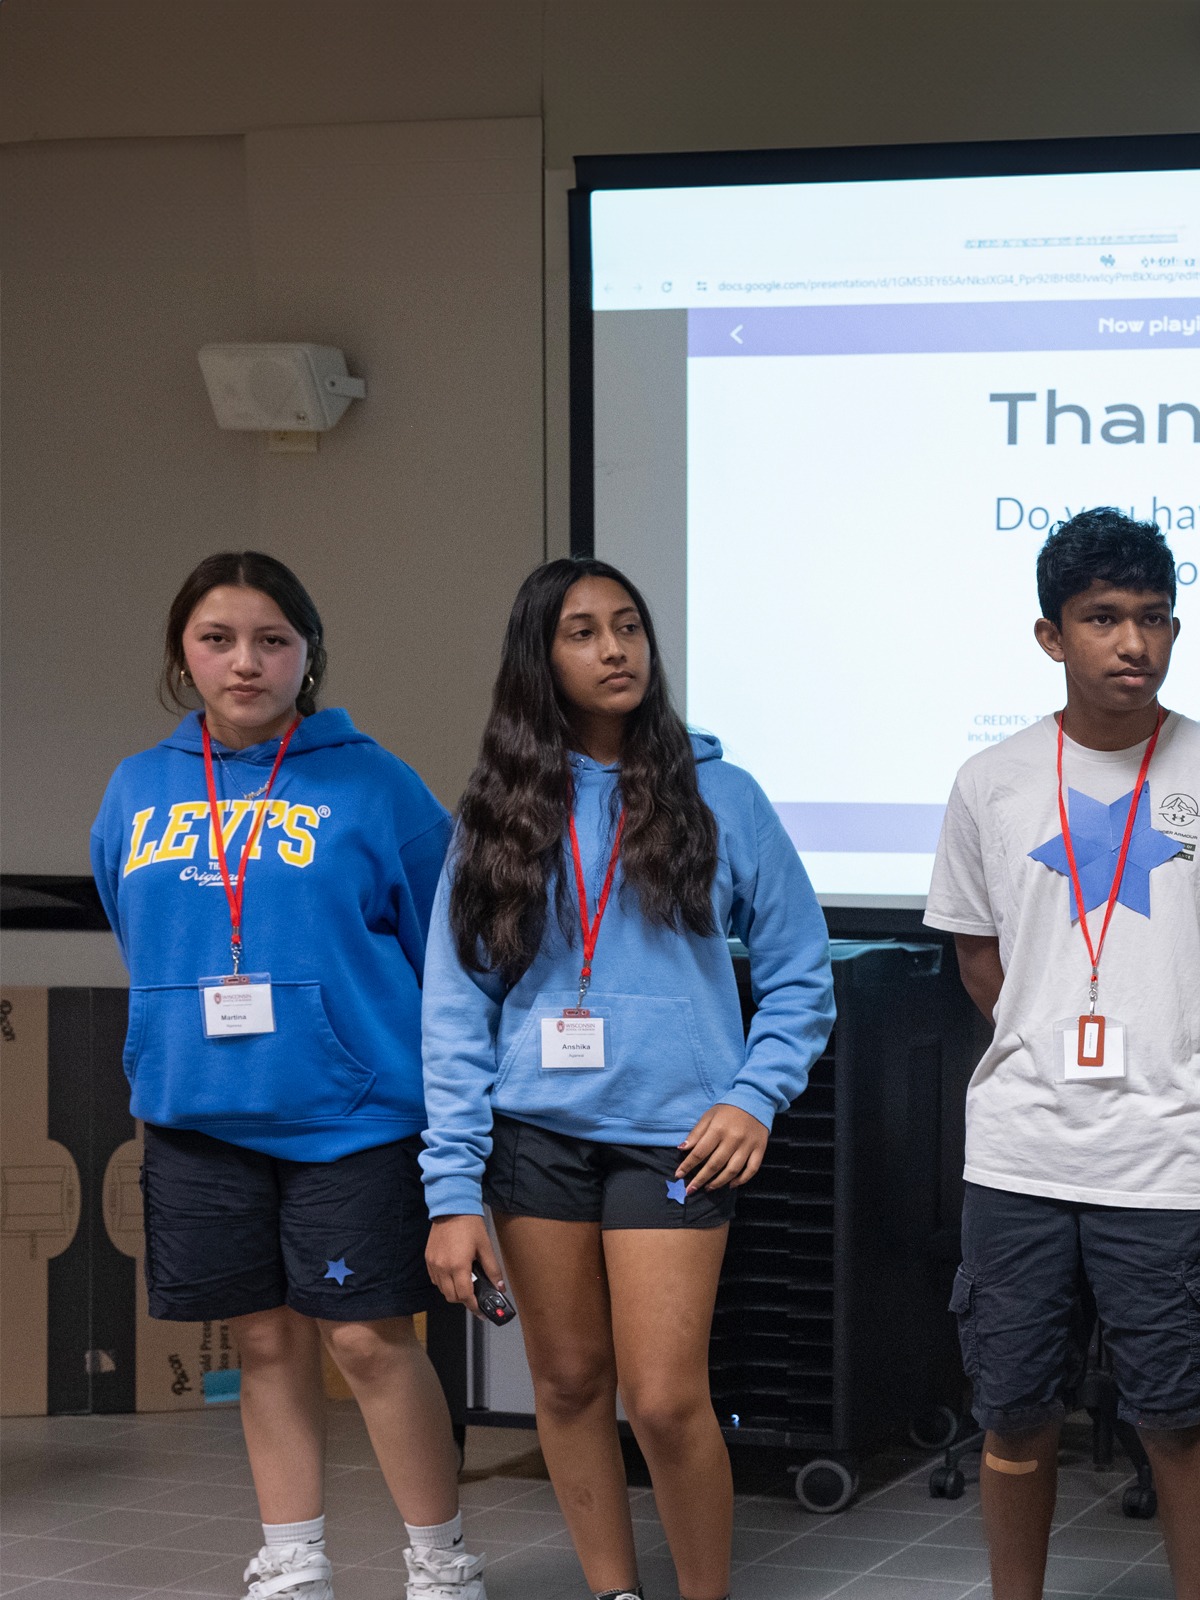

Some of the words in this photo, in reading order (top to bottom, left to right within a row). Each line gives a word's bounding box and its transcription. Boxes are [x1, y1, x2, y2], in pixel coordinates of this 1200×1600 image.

[1098, 317, 1145, 334] Now
[995, 497, 1050, 531] Do
[974, 714, 1029, 727] CREDITS:
